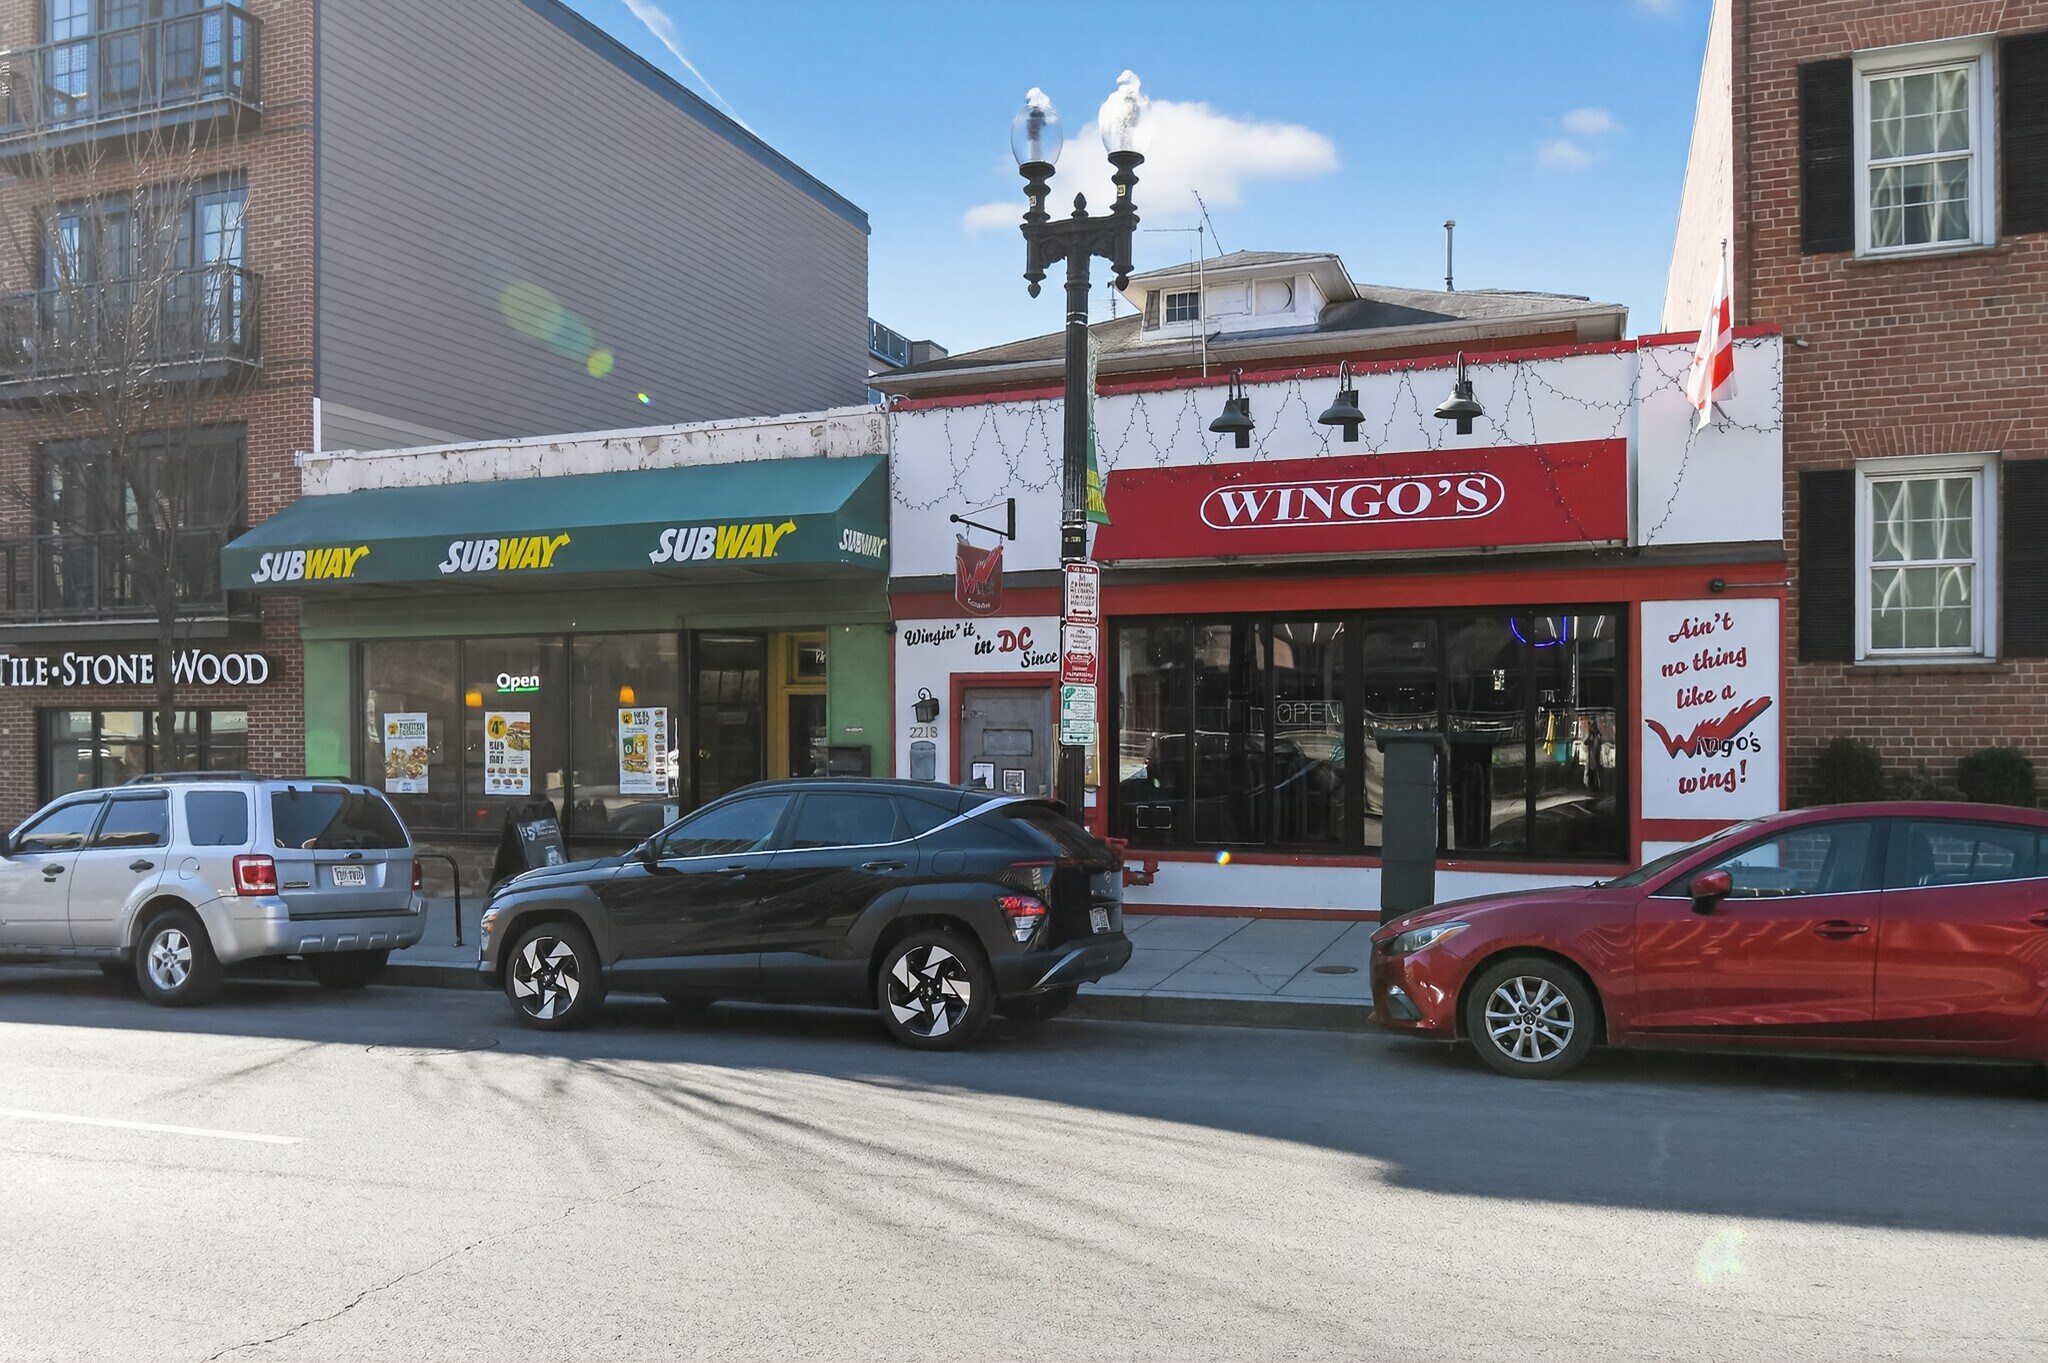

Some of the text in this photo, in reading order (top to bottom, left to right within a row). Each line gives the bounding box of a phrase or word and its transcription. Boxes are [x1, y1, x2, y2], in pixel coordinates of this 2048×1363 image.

[1218, 477, 1488, 523] WINGO'S
[438, 531, 571, 575] SUBWAY
[649, 518, 797, 565] SUBWAY
[251, 544, 370, 584] SUBWAY
[904, 622, 975, 646] Wingin' it
[974, 626, 1034, 655] in DC
[1668, 612, 1734, 643] Ain't
[63, 652, 154, 685] STONE
[171, 649, 268, 685] WOOD
[1021, 651, 1058, 668] Since
[1692, 647, 1747, 672] thing
[497, 673, 540, 692] Open
[1676, 685, 1736, 709] like a
[1277, 703, 1340, 724] OPEN
[909, 726, 938, 739] 2218
[1679, 760, 1747, 794] wing!
